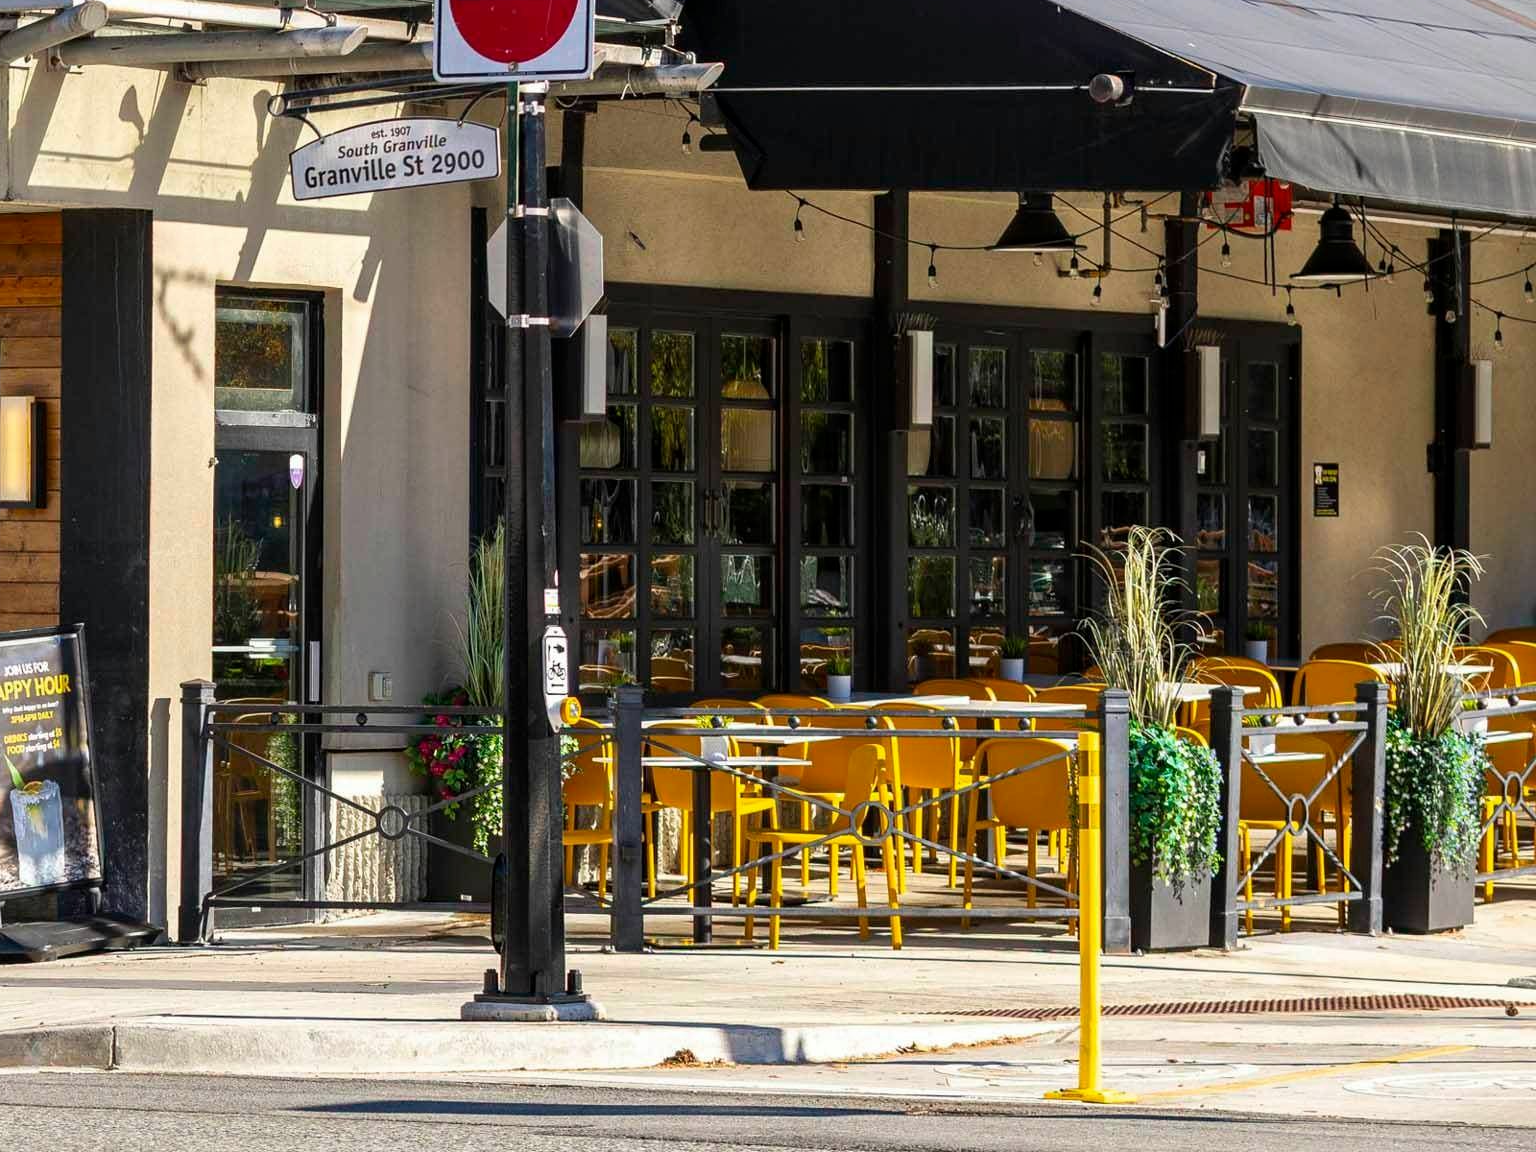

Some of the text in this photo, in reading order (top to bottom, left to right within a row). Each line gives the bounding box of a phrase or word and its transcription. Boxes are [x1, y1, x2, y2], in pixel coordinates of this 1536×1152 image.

[371, 126, 411, 139] est. 1907
[338, 134, 447, 160] South Granville
[304, 149, 485, 189] Granville St 2900
[4, 661, 50, 677] JOIN US FOR
[34, 674, 71, 696] HOUR
[4, 733, 28, 744] DRINKS
[7, 745, 25, 755] FOOD
[25, 742, 47, 752] starting
